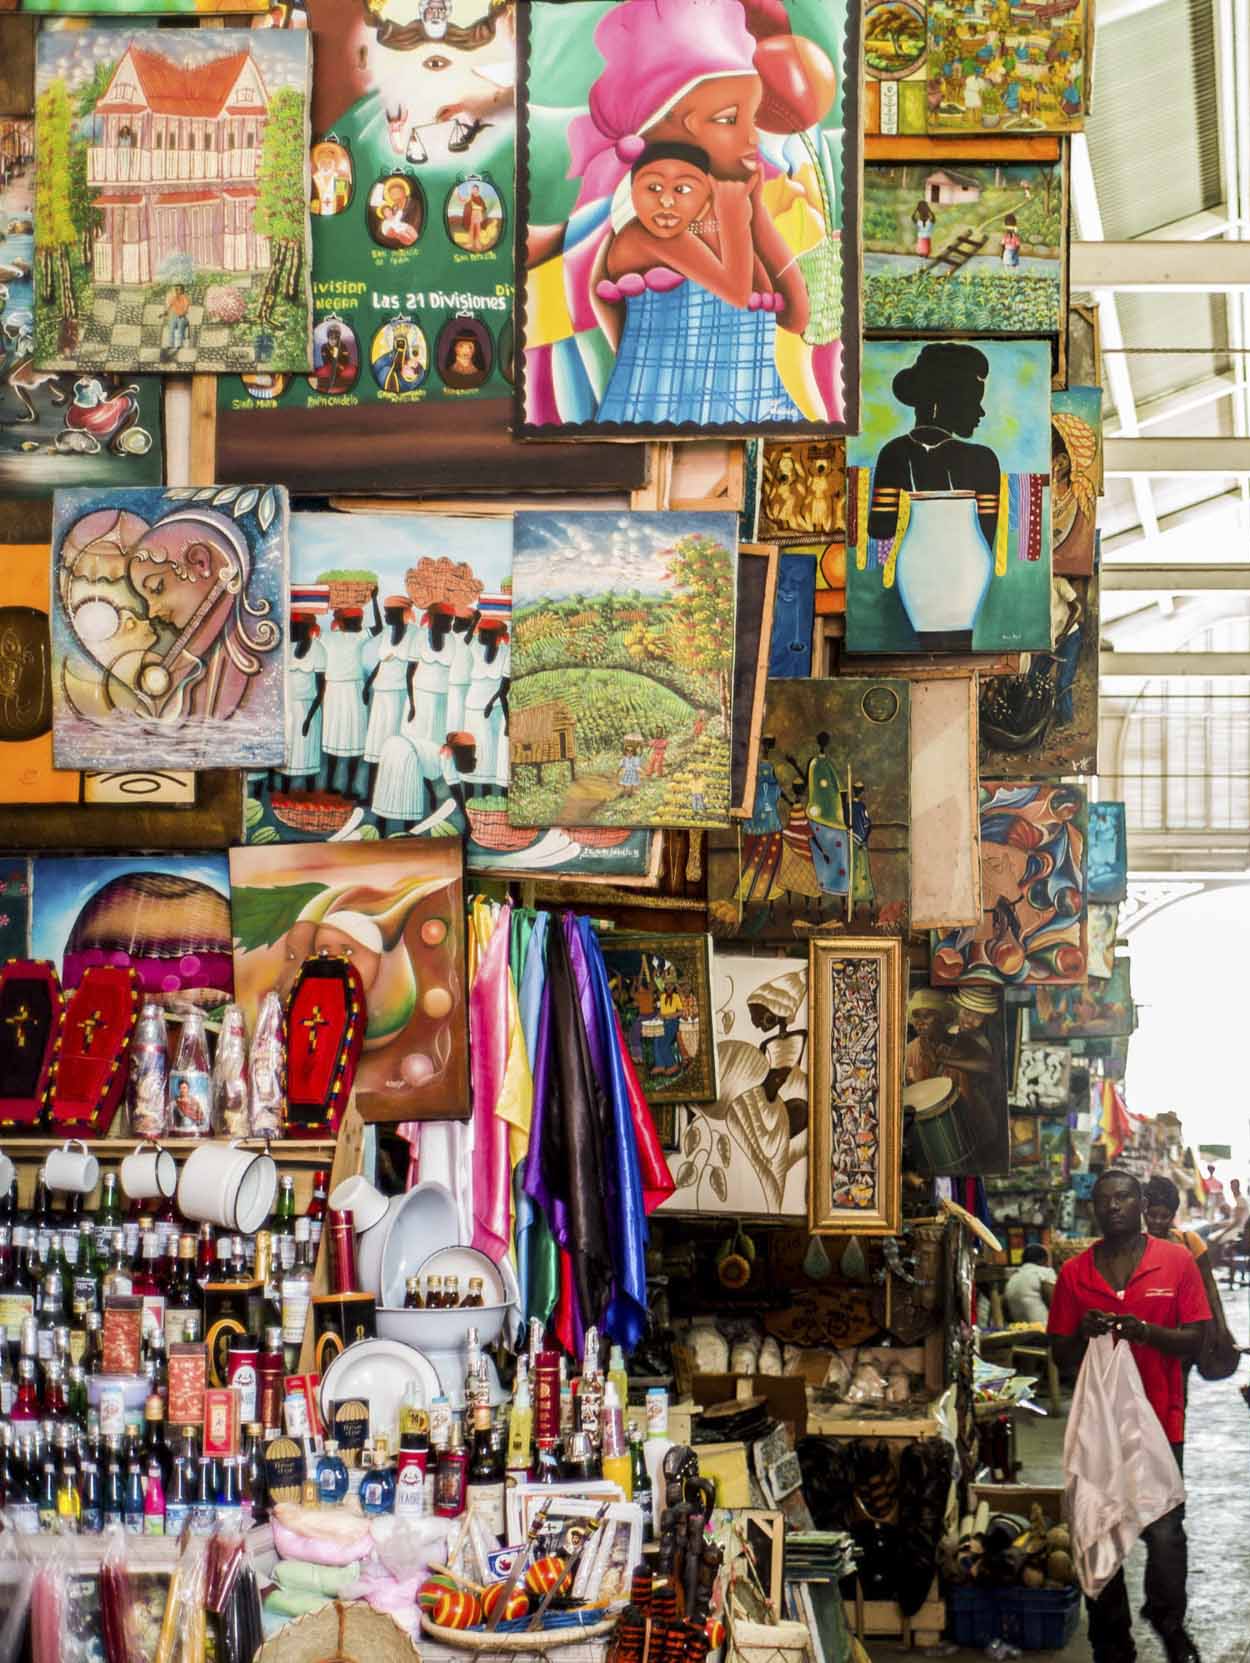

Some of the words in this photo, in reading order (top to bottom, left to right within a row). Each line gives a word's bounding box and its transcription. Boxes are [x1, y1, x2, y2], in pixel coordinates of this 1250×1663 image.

[313, 280, 367, 295] ivision
[372, 292, 400, 309] Las
[406, 293, 425, 309] 21
[430, 291, 507, 311] Divisiones
